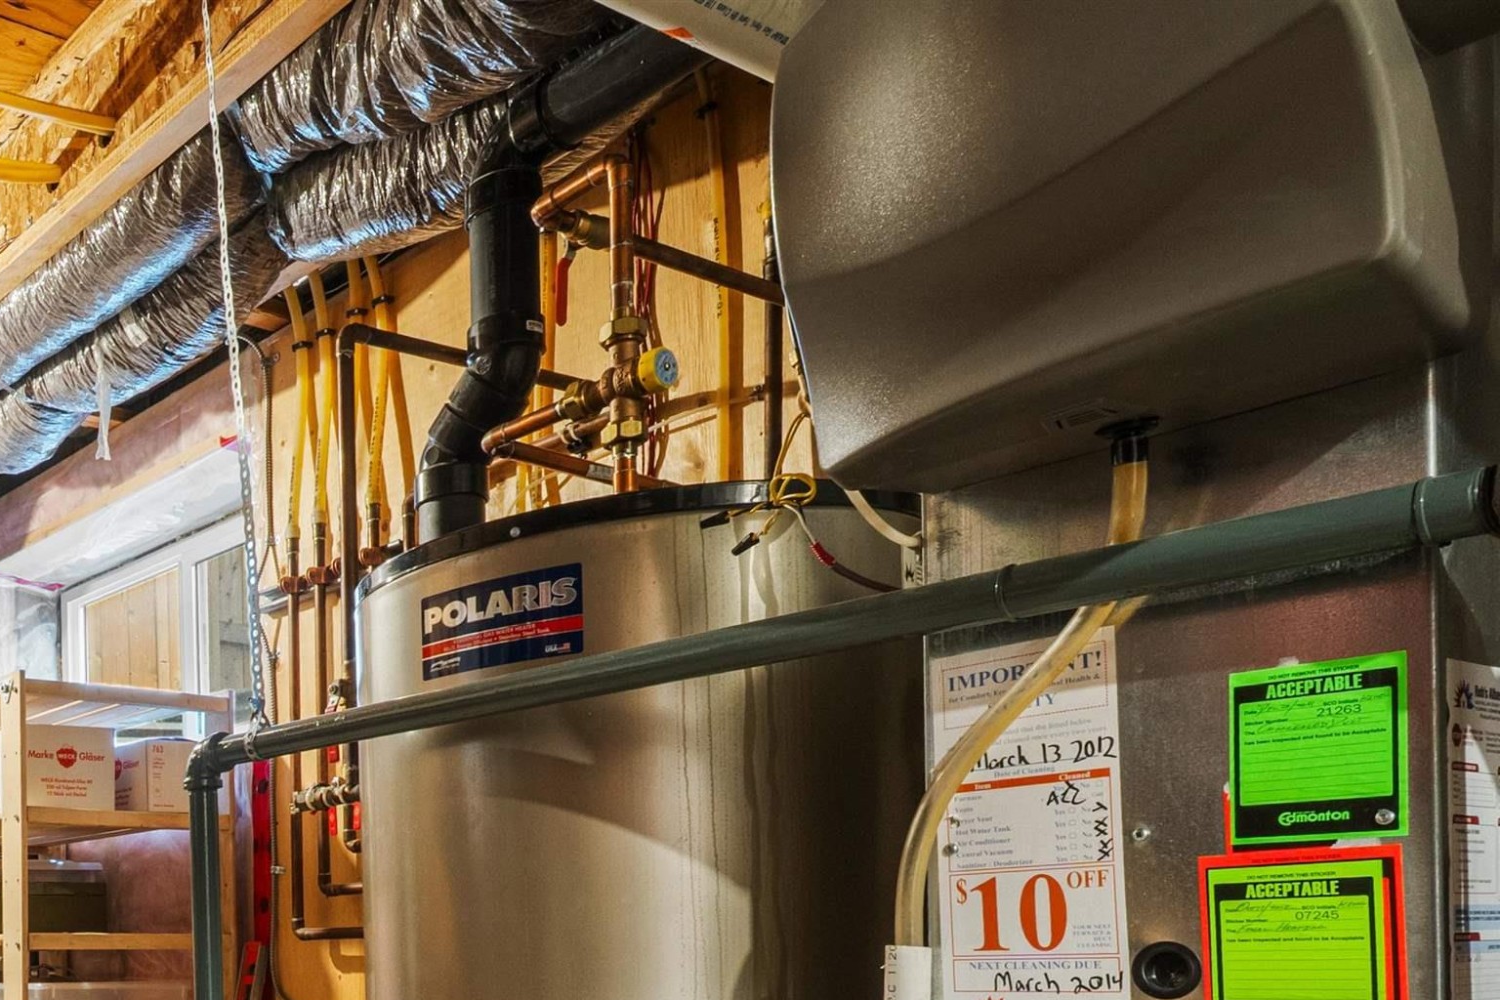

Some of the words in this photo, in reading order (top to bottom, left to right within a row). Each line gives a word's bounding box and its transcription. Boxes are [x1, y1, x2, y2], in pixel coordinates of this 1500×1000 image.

[424, 577, 578, 635] POLARIS
[1291, 670, 1317, 678] REMOVE
[1333, 664, 1359, 672] STICKER
[1266, 673, 1362, 699] ACCEPTABLE
[1316, 703, 1362, 718] 21263
[28, 749, 54, 760] Marke
[78, 751, 105, 761] Gläser
[971, 746, 1029, 772] March
[1042, 743, 1061, 763] 13
[1070, 736, 1117, 762] 2012
[1058, 771, 1091, 781] Cleaned
[1278, 810, 1350, 826] Edmonton
[1067, 869, 1109, 889] OFF
[1245, 880, 1339, 899] ACCEPTABLE
[1295, 910, 1339, 921] 07245
[969, 961, 1000, 970] NEXT
[1005, 961, 1070, 970] CLEANING
[1074, 960, 1102, 969] DUE
[994, 971, 1060, 994] March
[1071, 971, 1124, 994] 2014
